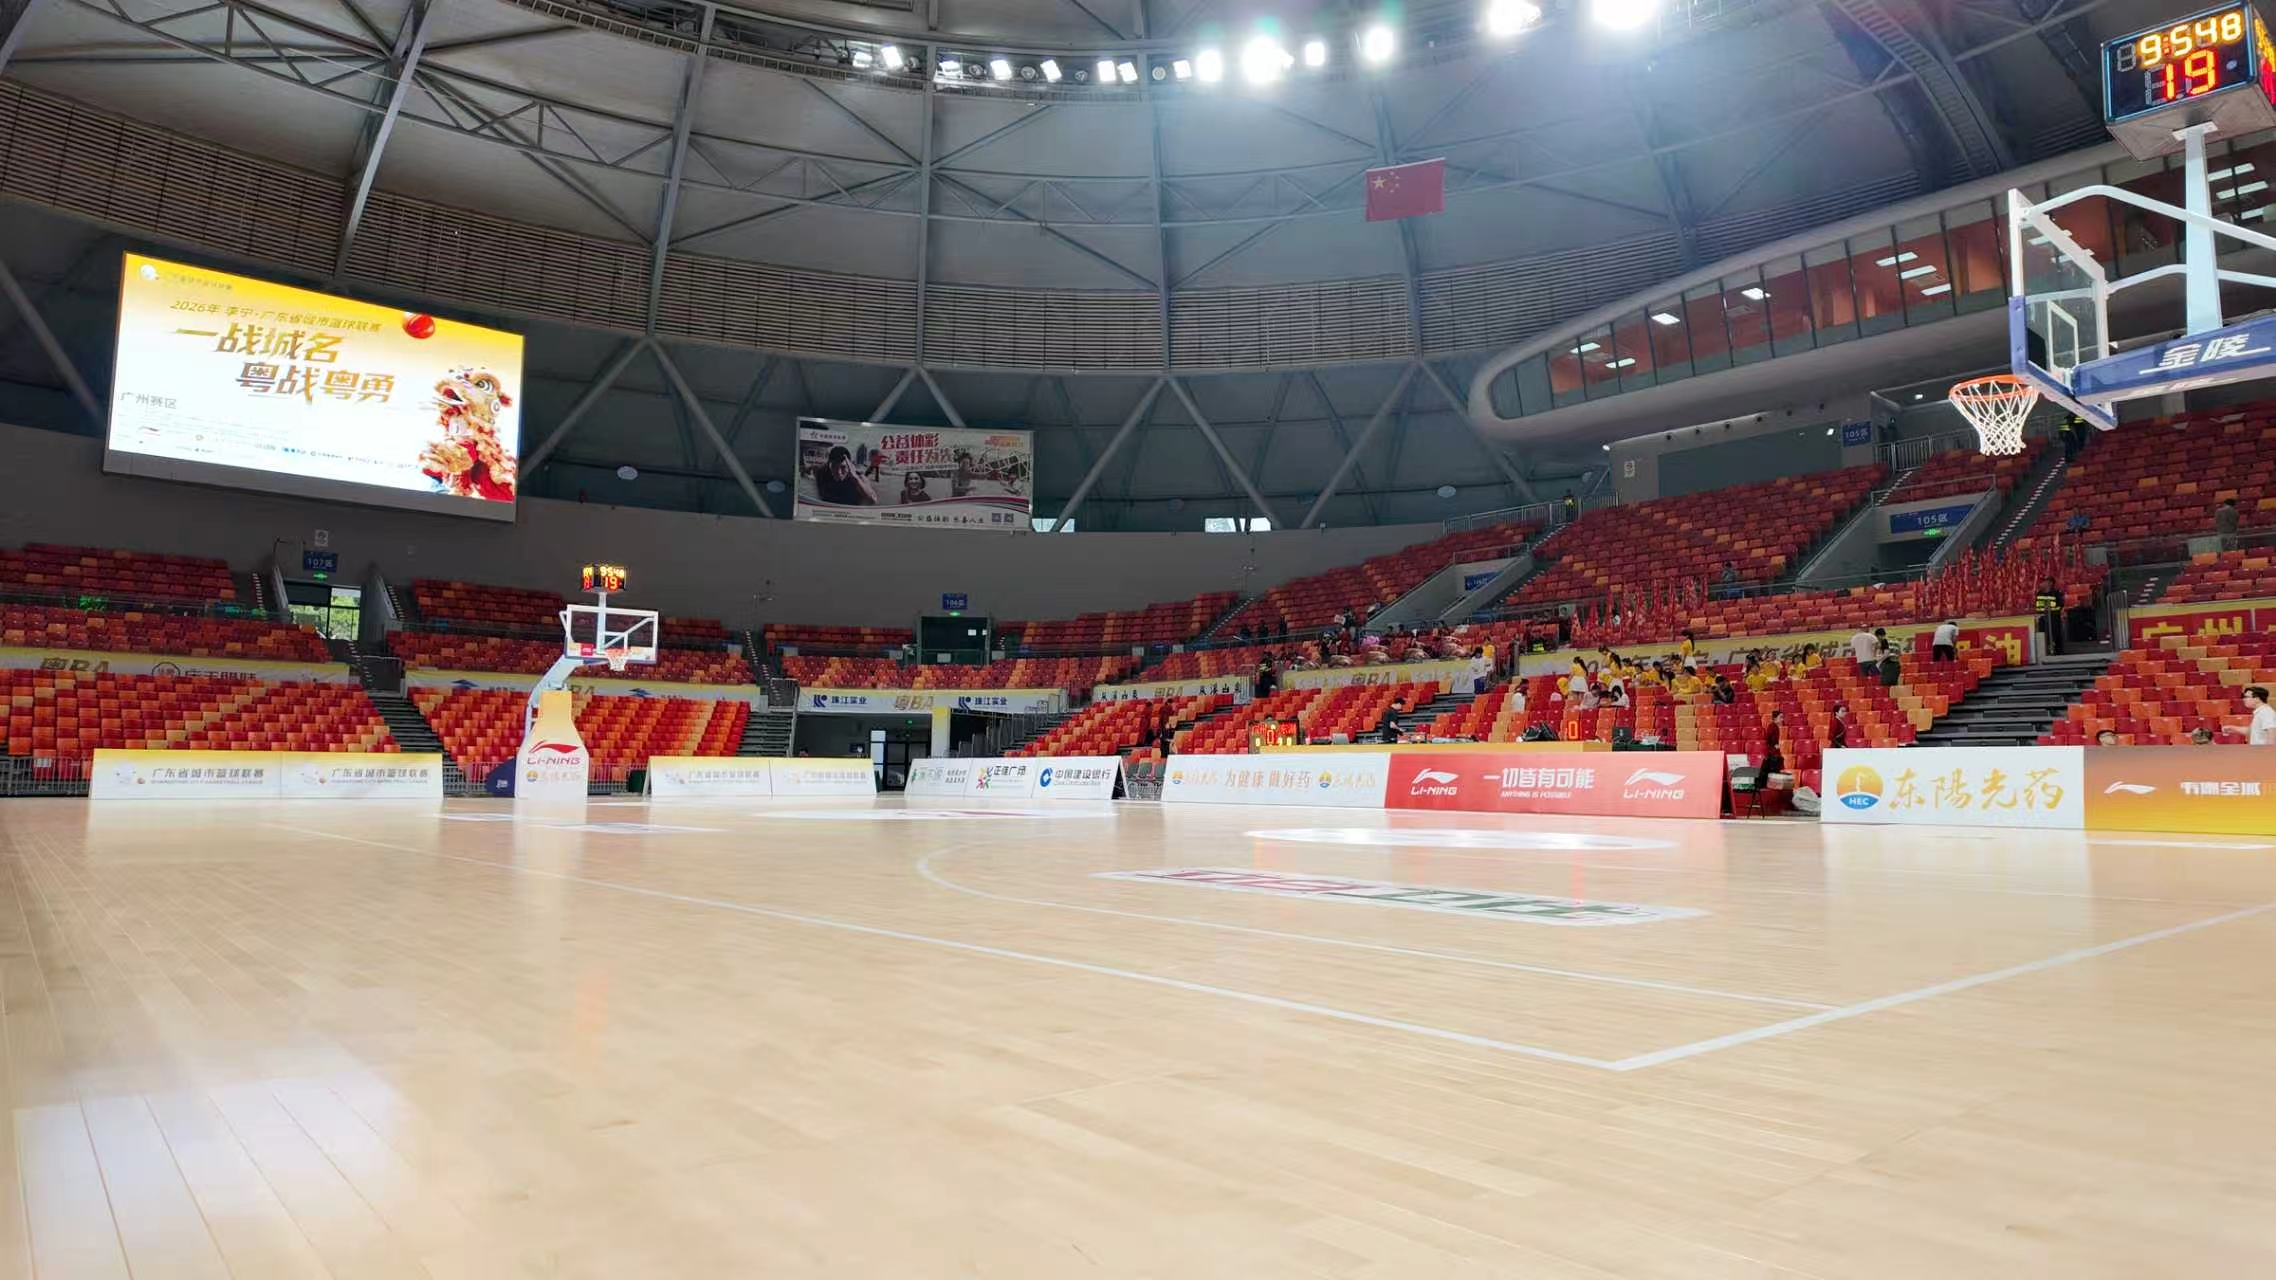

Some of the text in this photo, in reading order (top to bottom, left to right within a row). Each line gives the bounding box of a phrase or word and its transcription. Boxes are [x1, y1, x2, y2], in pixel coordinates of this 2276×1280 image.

[2165, 49, 2216, 99] 19
[172, 322, 344, 363] 一战城名
[2139, 333, 2271, 375] 金陵
[236, 362, 396, 404] 粤战粤勇
[1918, 513, 1948, 526] 105区
[1567, 720, 1580, 740] 0
[1483, 767, 1595, 789] 一切皆有可能
[1410, 786, 1458, 796] LI-NING
[1623, 789, 1685, 800] LI-NING
[1849, 797, 1869, 807] HEC
